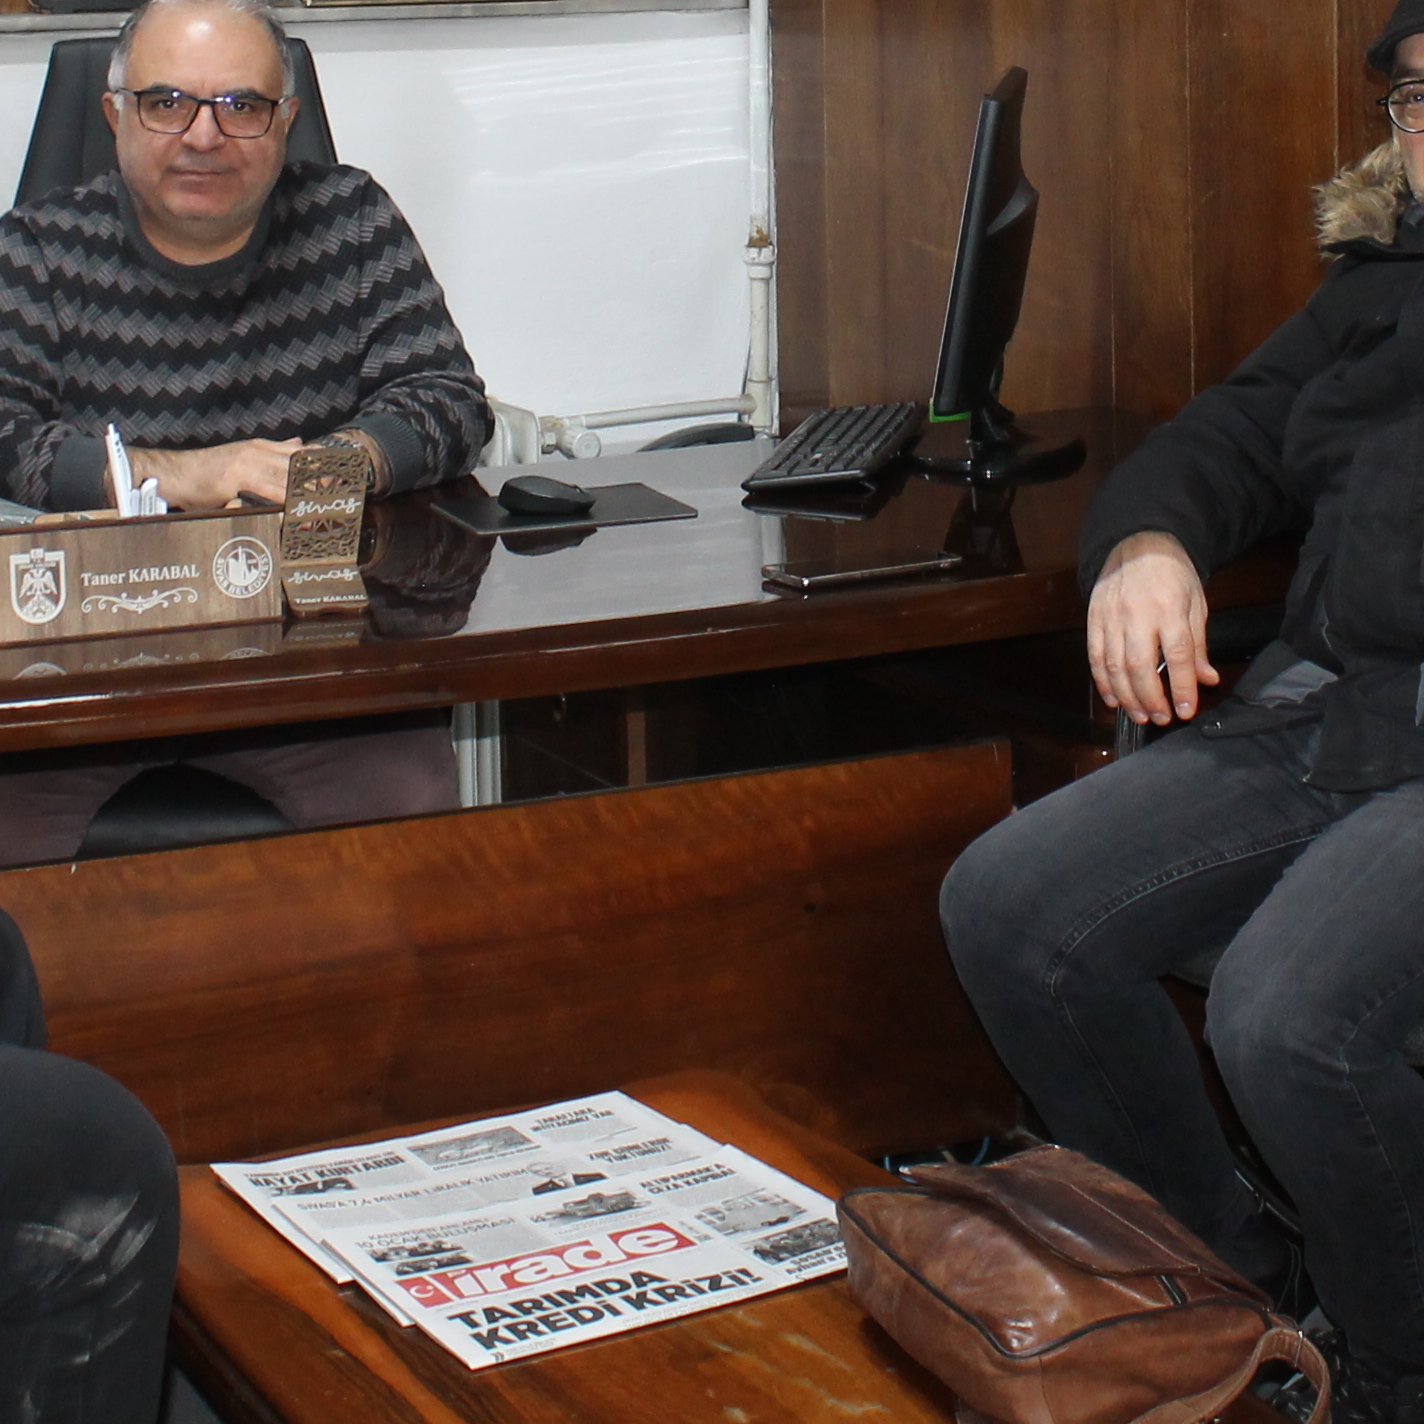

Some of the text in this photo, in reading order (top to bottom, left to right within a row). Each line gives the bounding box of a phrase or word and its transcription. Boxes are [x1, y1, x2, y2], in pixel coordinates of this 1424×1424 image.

[80, 564, 200, 587] Taner KARABAL
[249, 1171, 311, 1188] HAYAT
[376, 1234, 420, 1249] OCAK
[447, 1269, 672, 1329] TARIMDA
[469, 1300, 623, 1351] KREDİ
[617, 1267, 765, 1312] KRİZİ!
